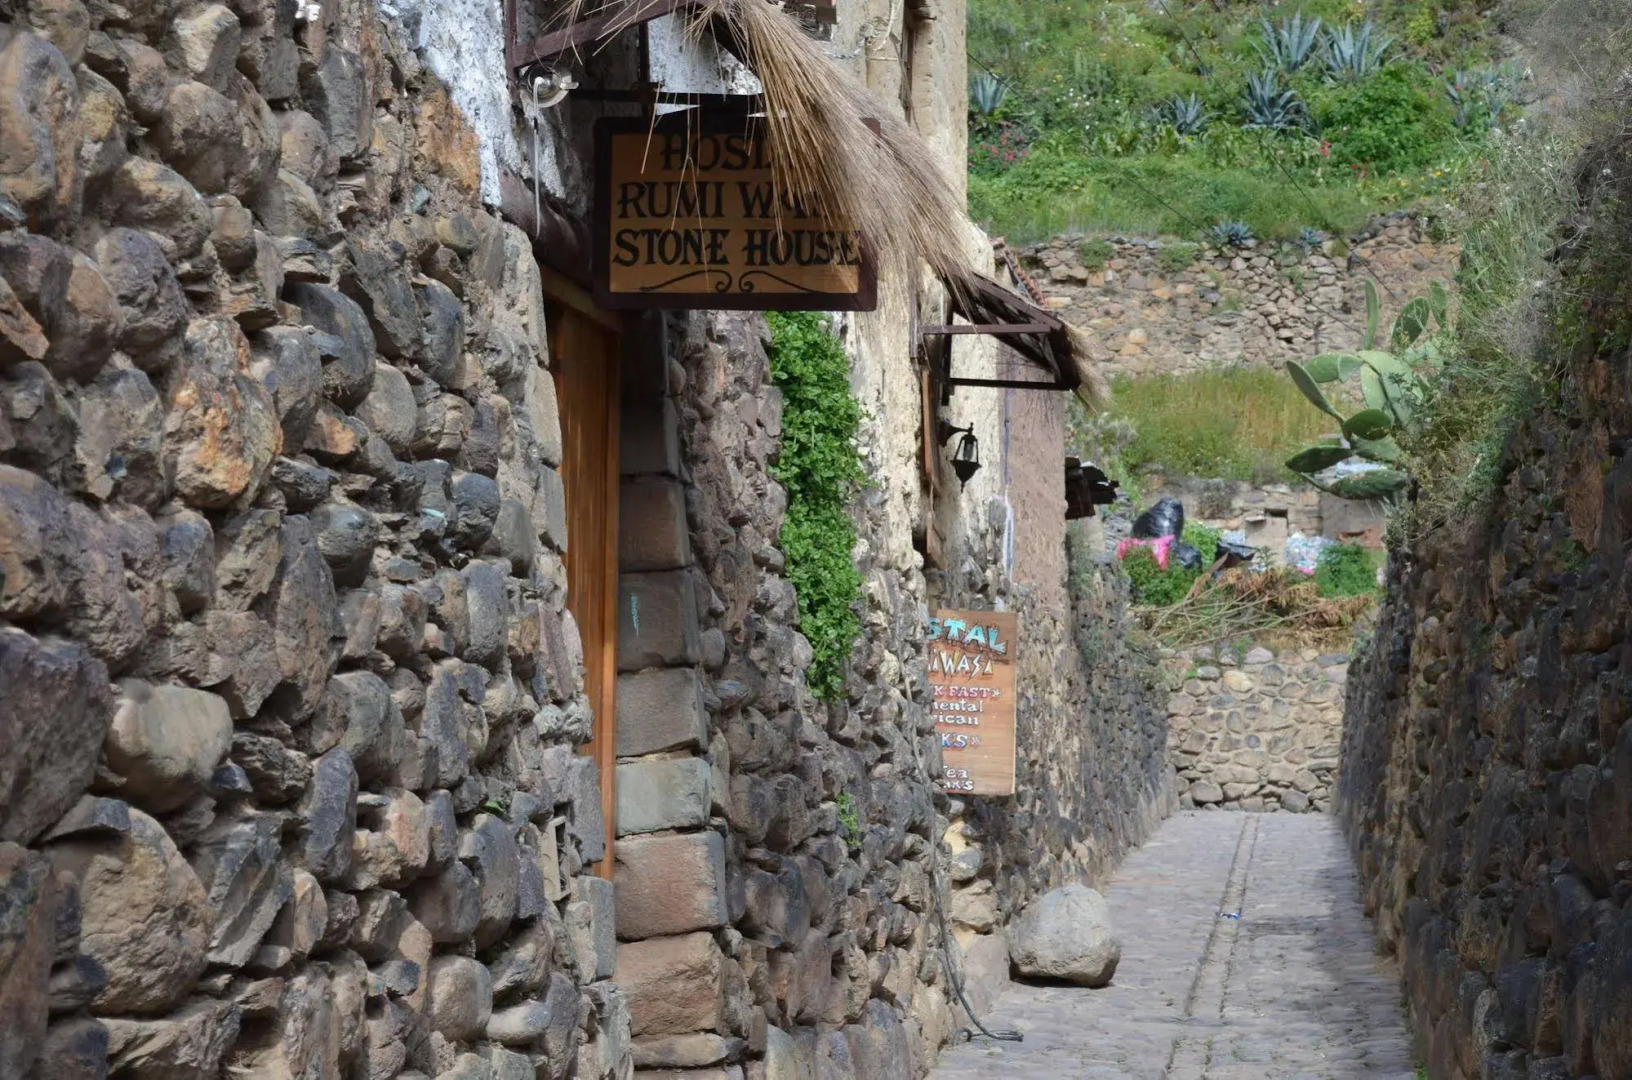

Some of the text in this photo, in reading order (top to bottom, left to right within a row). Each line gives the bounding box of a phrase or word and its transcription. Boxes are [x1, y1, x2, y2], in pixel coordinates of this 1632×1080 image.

[617, 181, 726, 218] RUMI
[612, 229, 861, 266] STONE HOUSE
[949, 685, 991, 698] FAST
